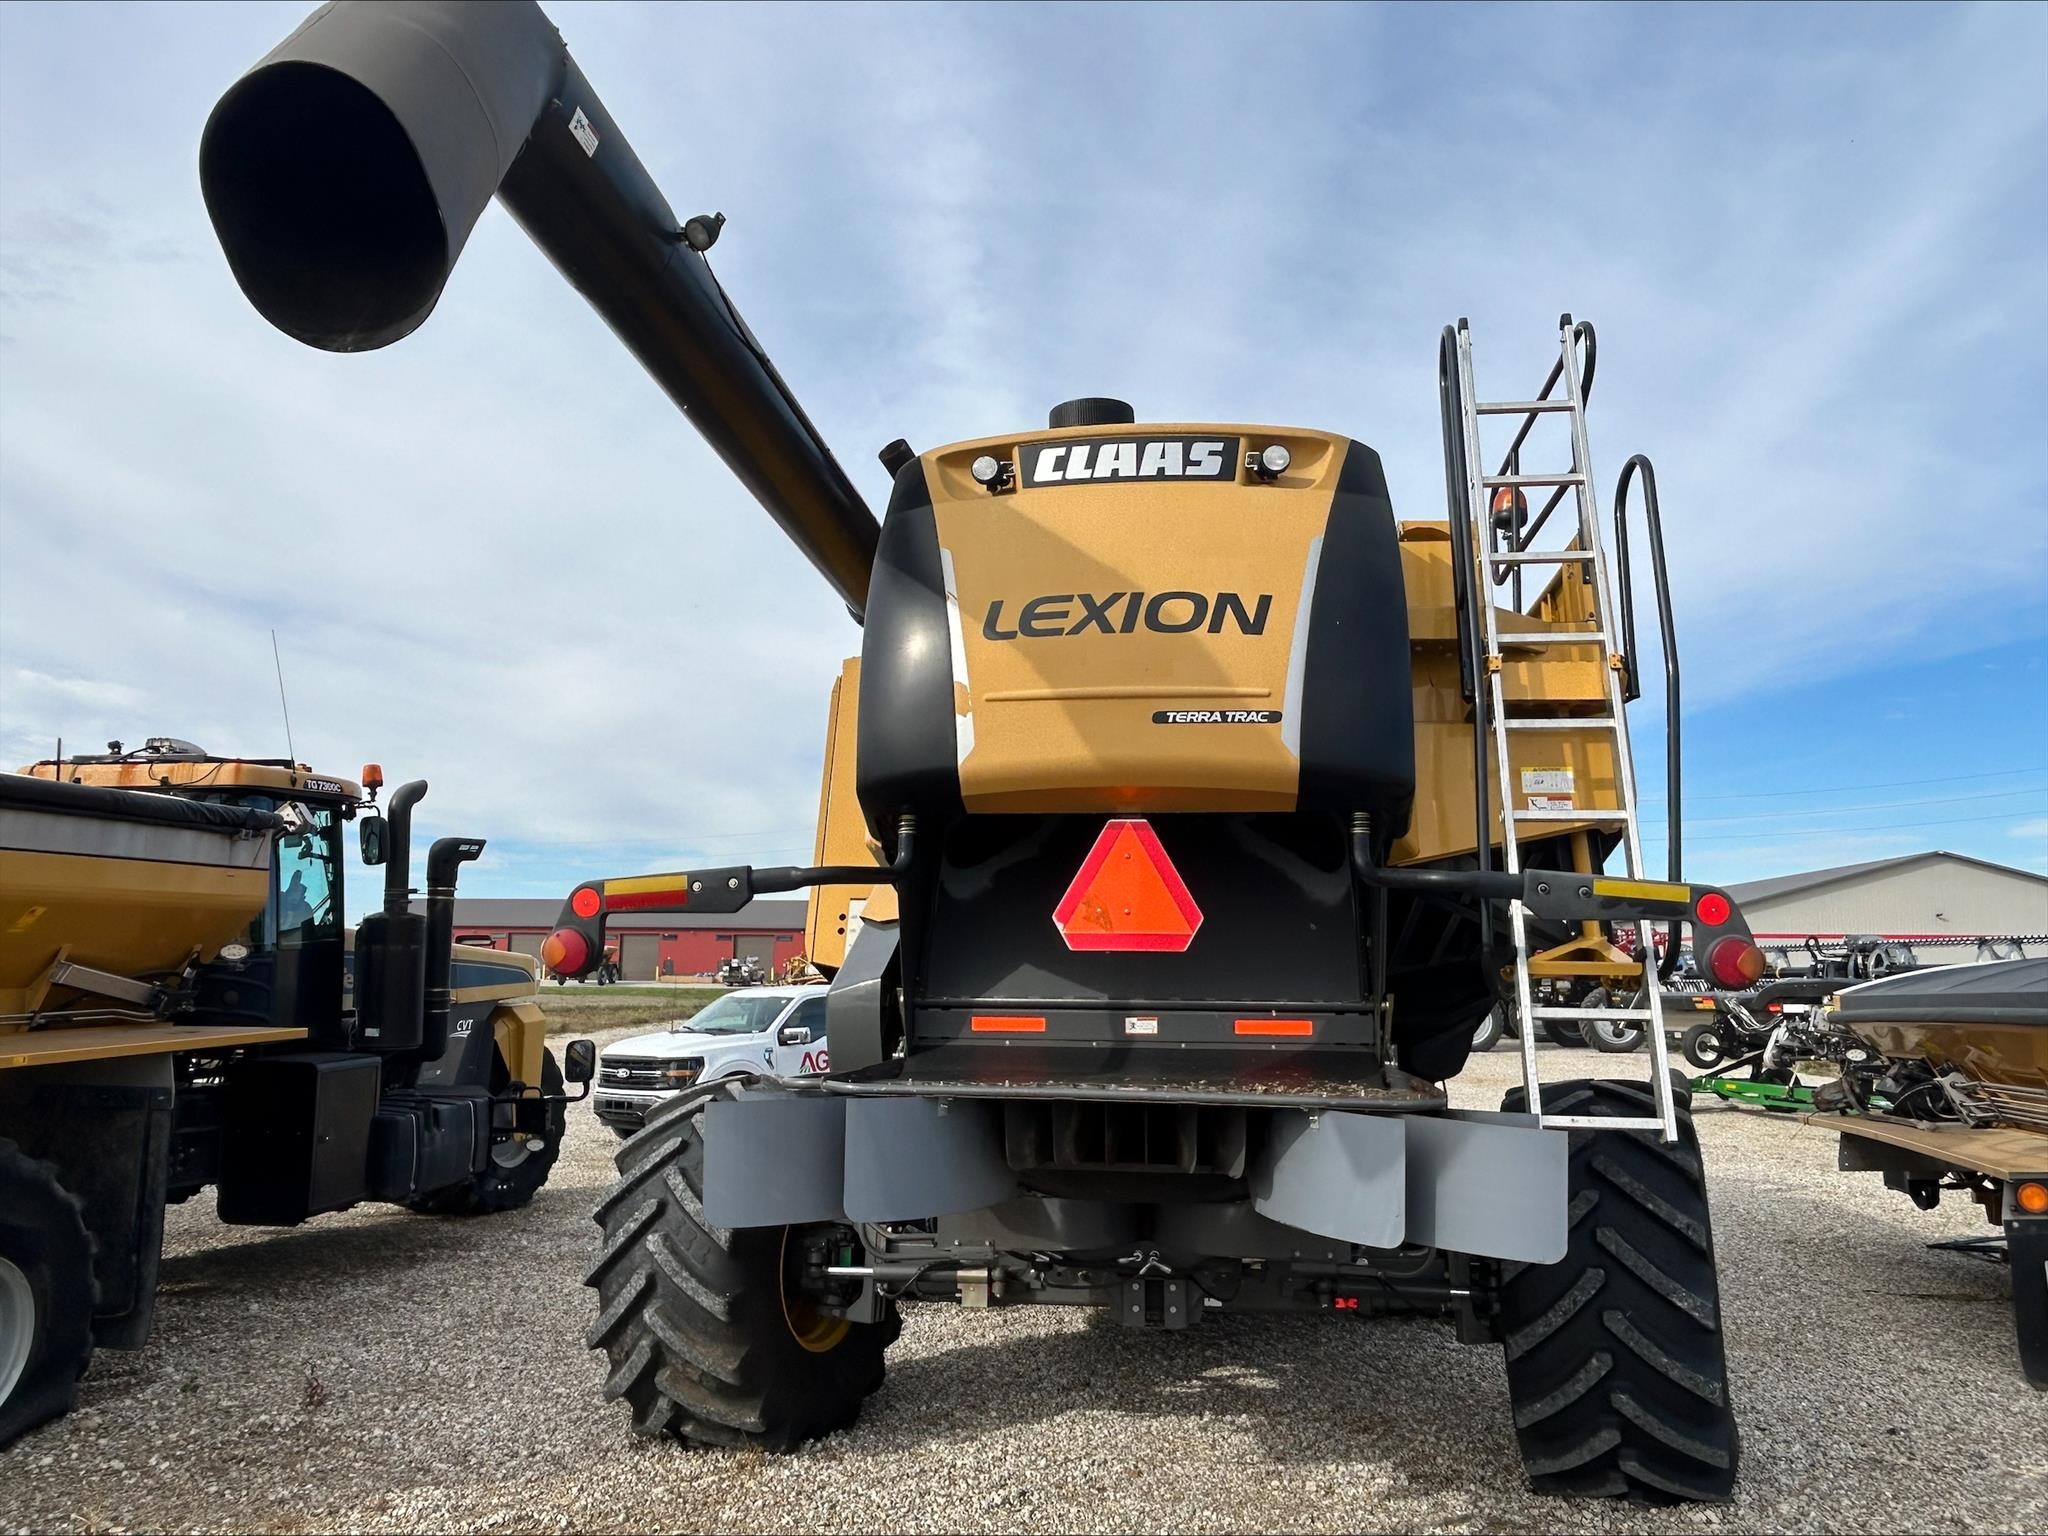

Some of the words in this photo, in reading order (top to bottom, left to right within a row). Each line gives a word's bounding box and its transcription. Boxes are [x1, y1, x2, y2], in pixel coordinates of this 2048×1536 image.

[1033, 442, 1225, 482] CLAAS
[982, 591, 1273, 641] LEXION
[1166, 711, 1222, 723] TERRA
[1225, 711, 1270, 723] TRAC
[456, 1019, 474, 1031] CVT
